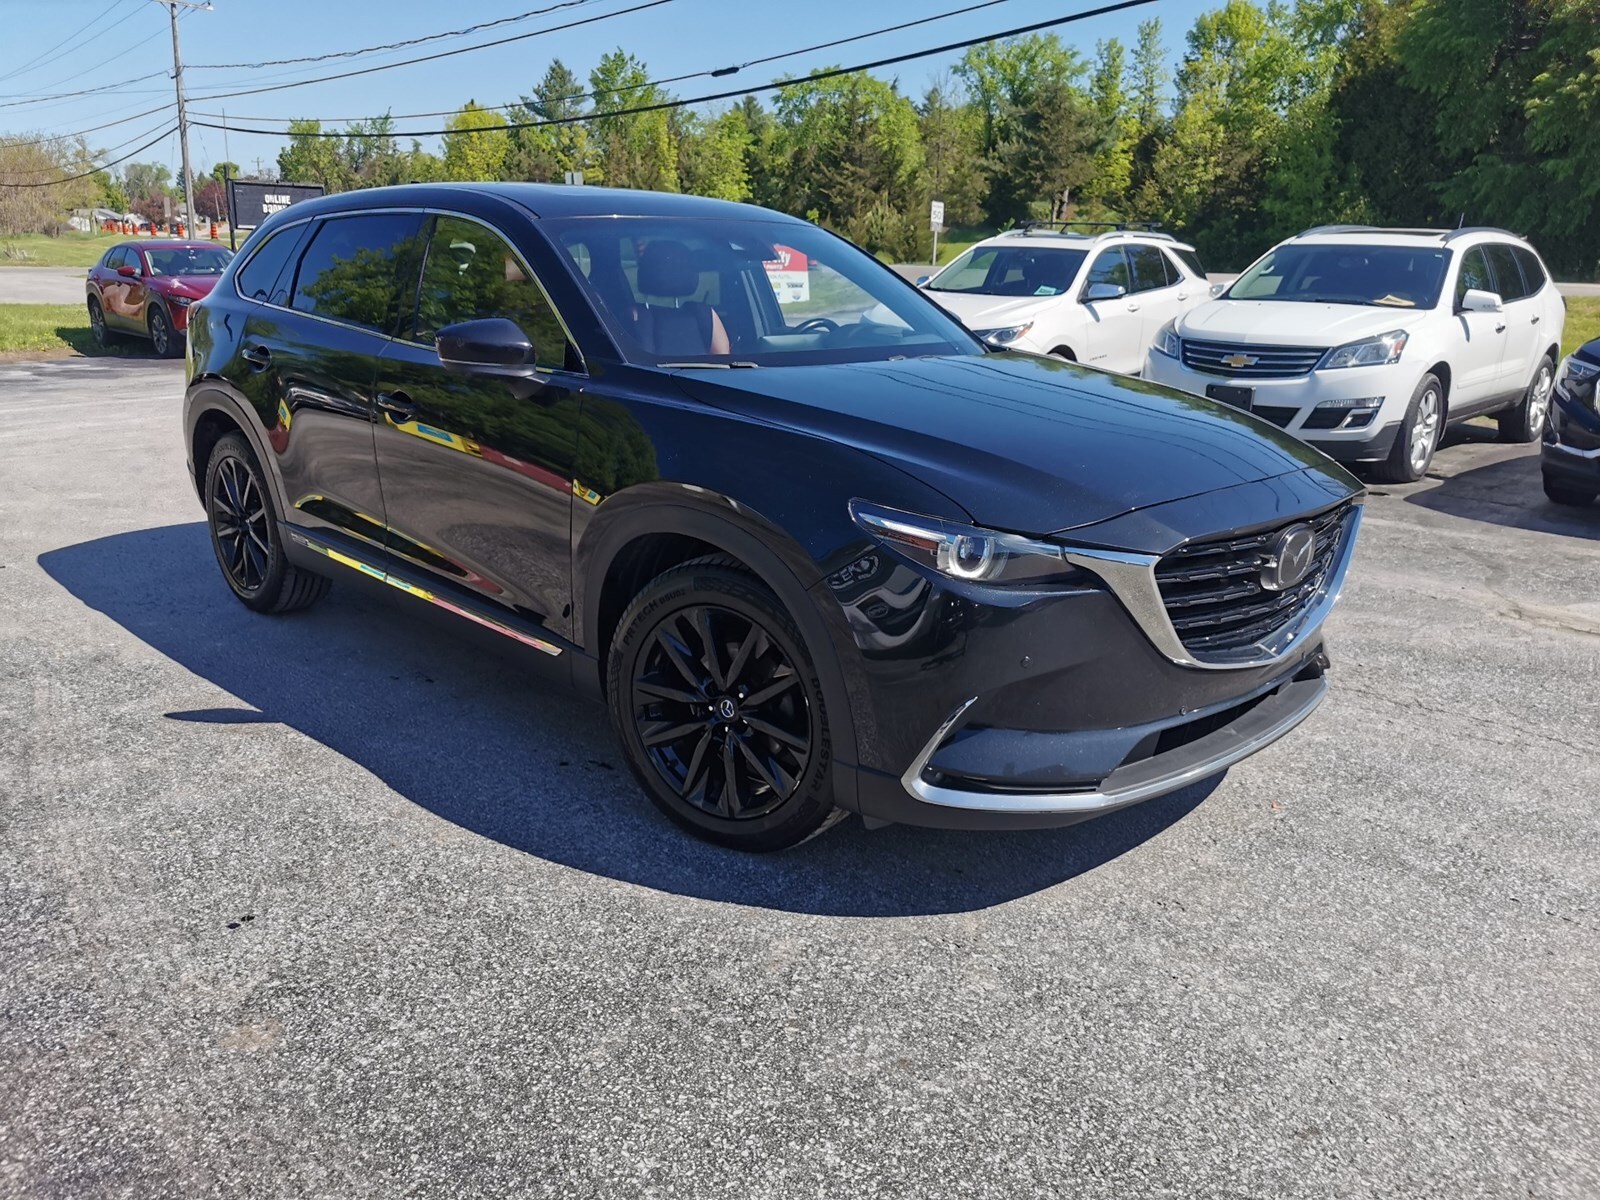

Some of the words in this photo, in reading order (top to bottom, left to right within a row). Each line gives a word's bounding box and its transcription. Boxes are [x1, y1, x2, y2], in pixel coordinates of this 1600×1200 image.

[264, 194, 291, 204] ONLINE
[933, 210, 942, 220] 50
[811, 677, 831, 793] DOUBLESTAR
